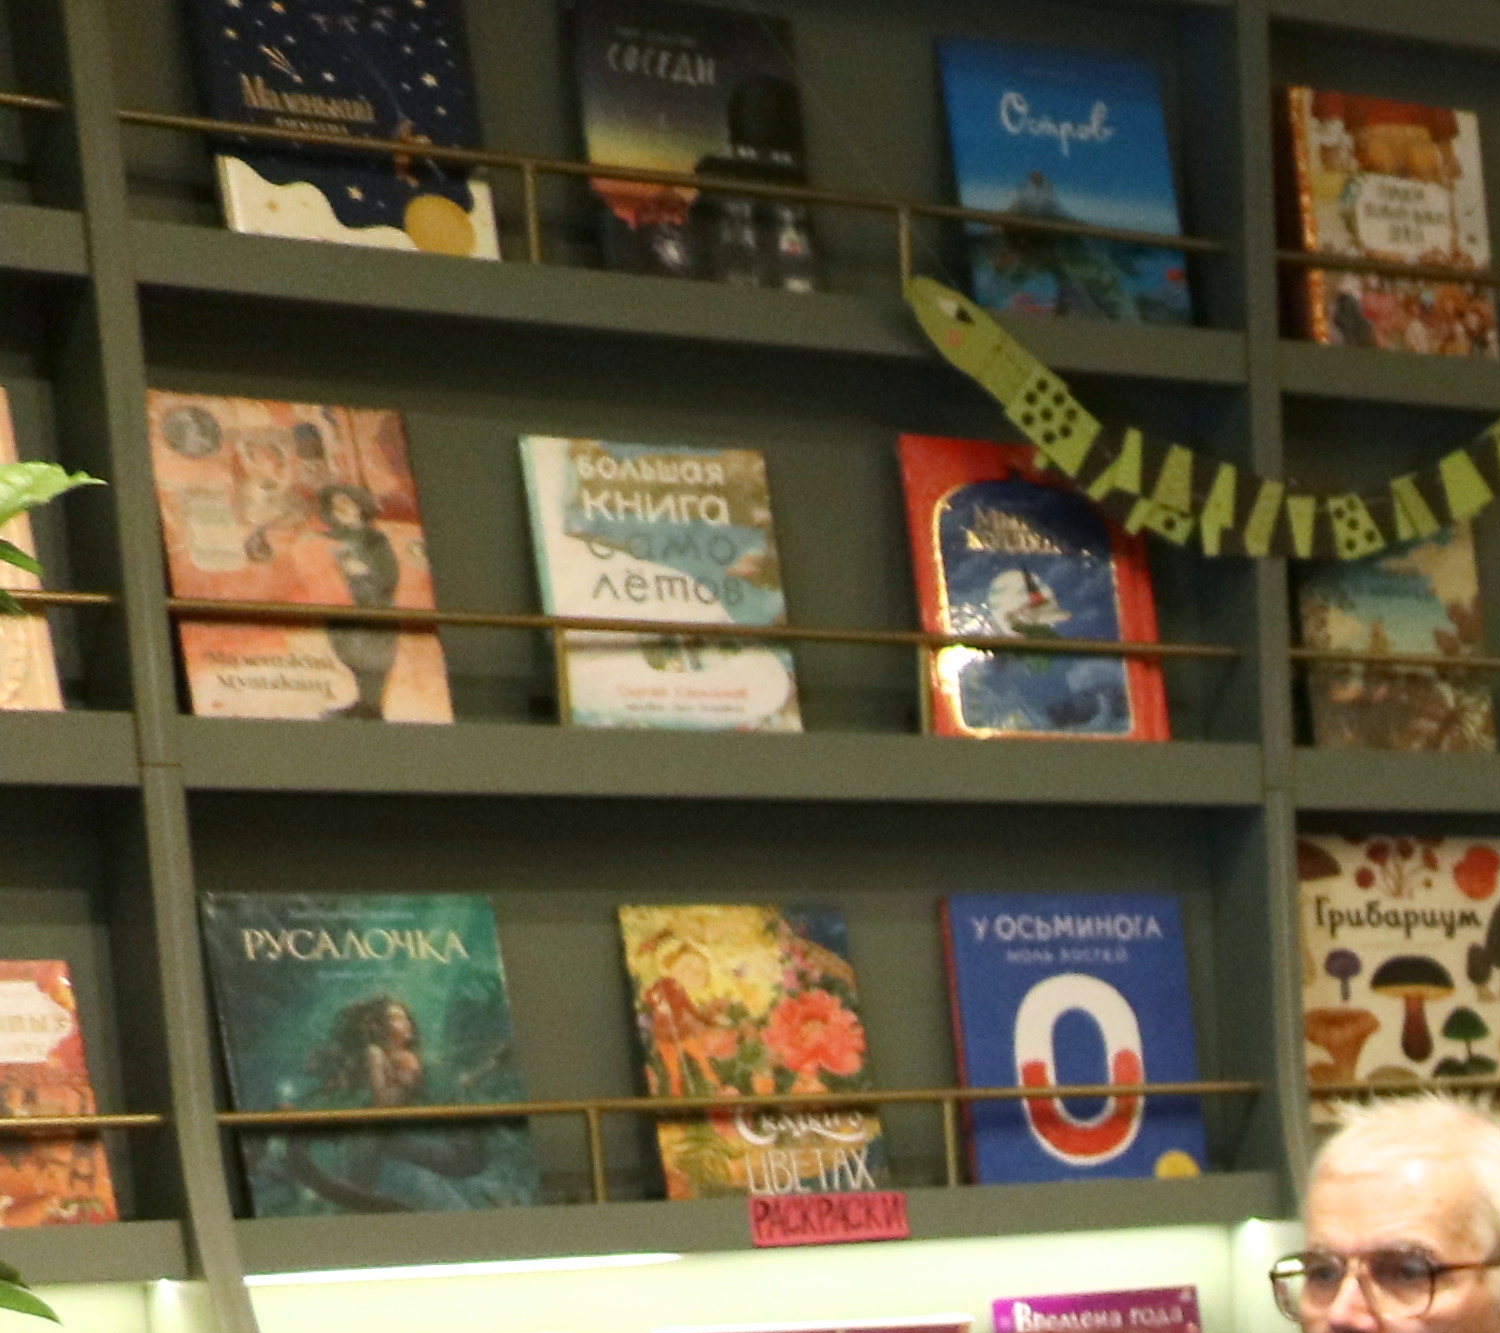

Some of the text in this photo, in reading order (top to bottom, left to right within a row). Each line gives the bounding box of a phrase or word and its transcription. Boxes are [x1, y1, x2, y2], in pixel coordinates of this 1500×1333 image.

[994, 913, 1163, 941] ОСЬМИНОГА
[1315, 896, 1482, 939] Грибариум
[241, 927, 470, 964] РУСАЛОЧКА
